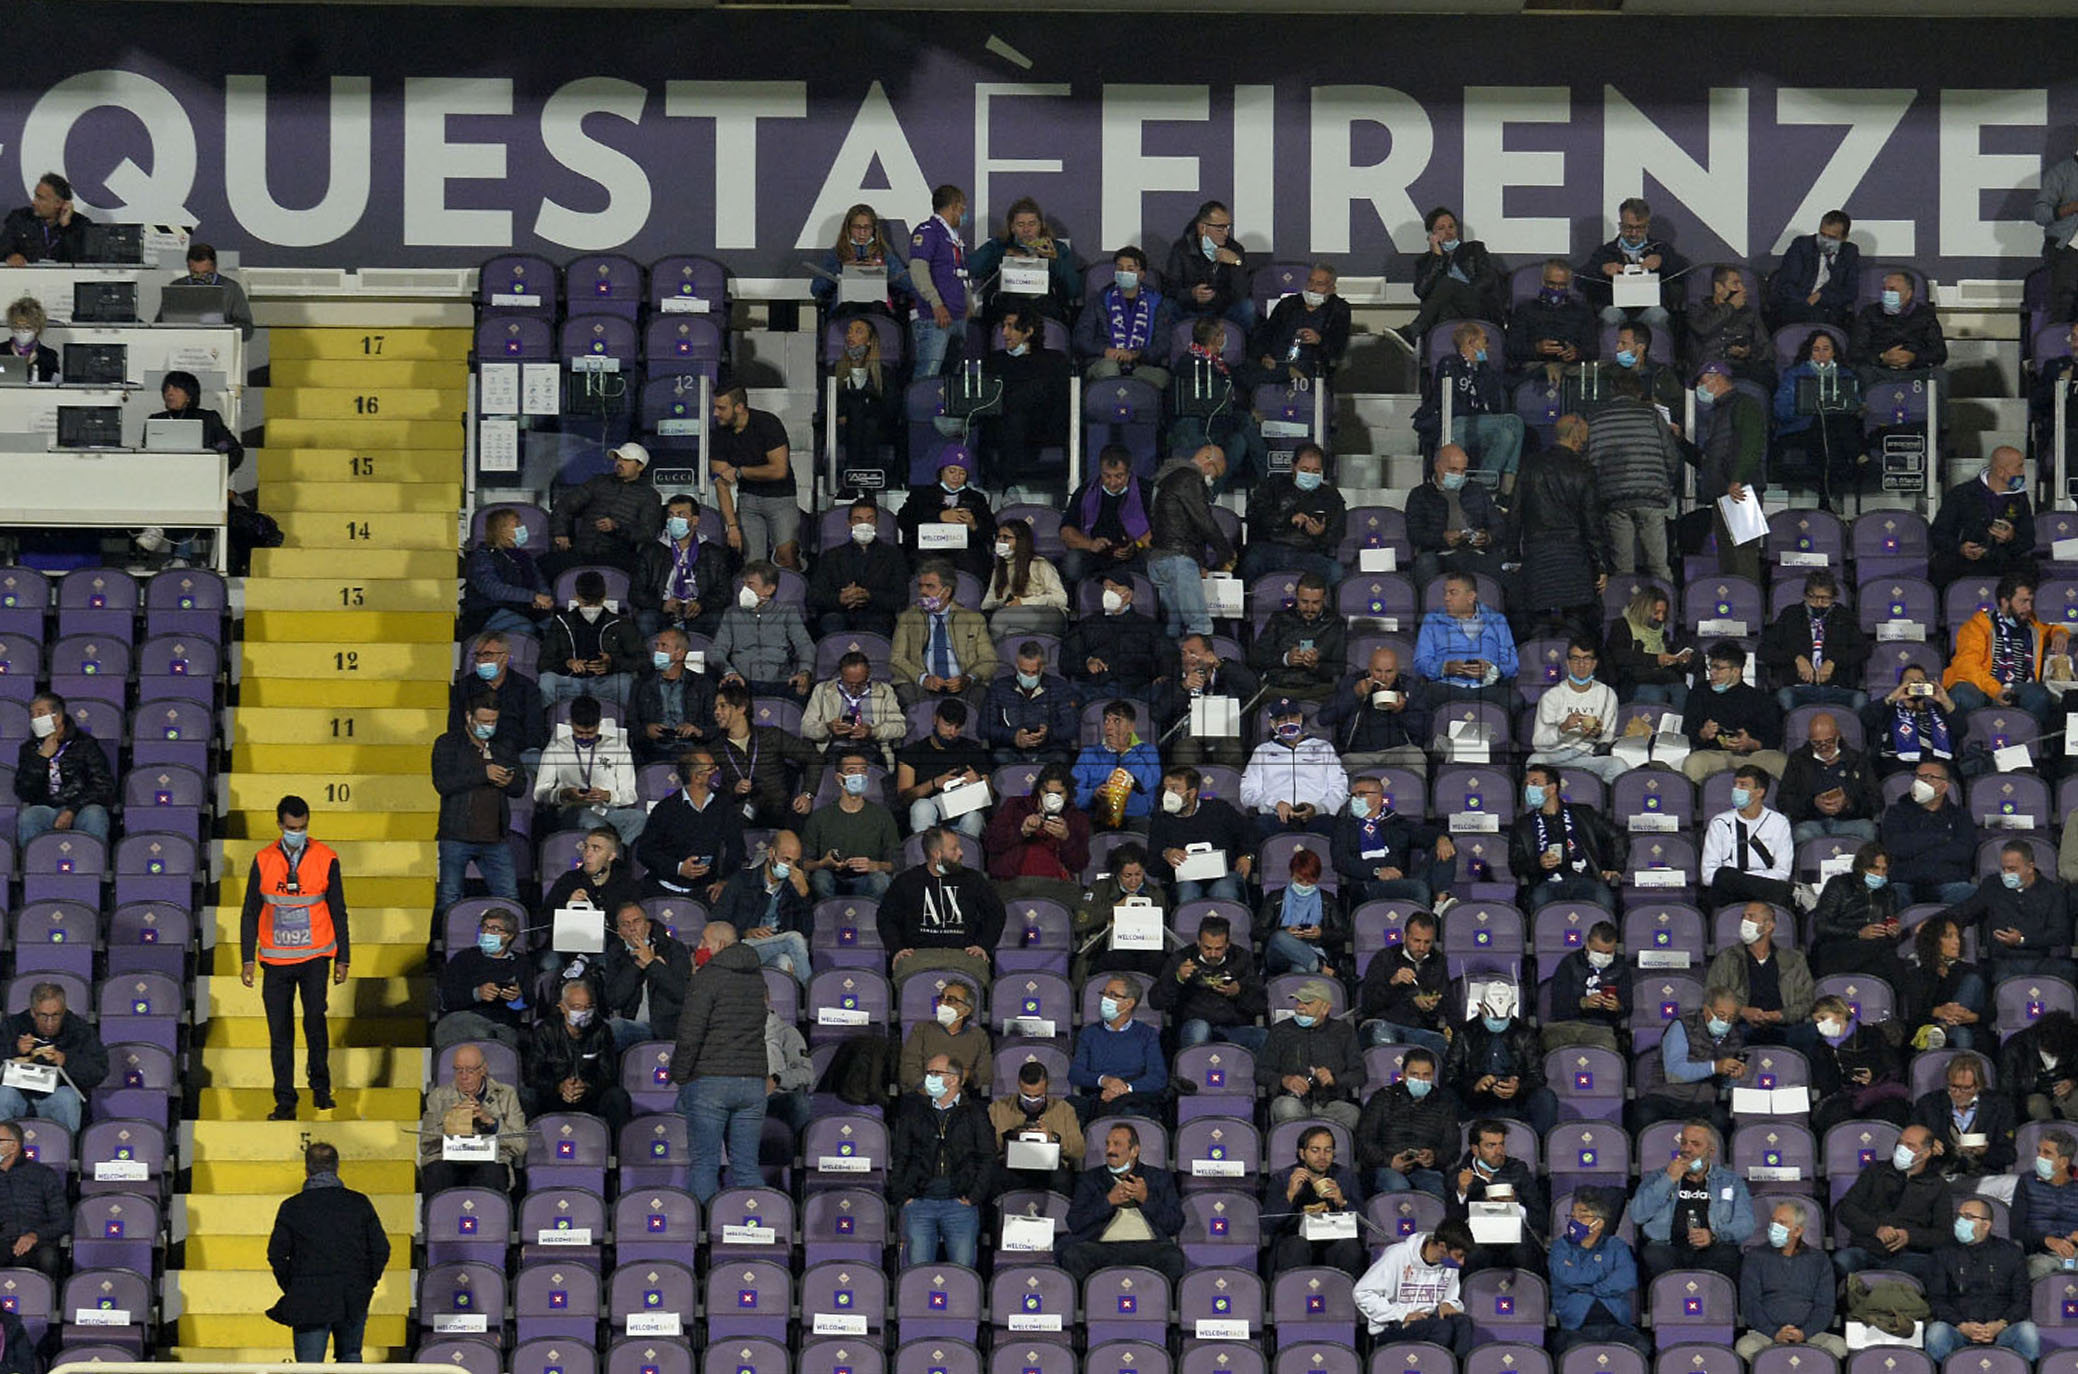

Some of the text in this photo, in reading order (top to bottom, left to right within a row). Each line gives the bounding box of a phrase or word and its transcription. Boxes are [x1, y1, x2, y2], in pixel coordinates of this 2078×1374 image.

[361, 337, 384, 355] 17
[675, 376, 693, 390] 12
[1291, 379, 1308, 392] 10
[1913, 380, 1923, 393] 8
[353, 396, 378, 414] 16
[350, 458, 373, 476] 15
[347, 522, 370, 540] 14
[340, 588, 364, 606] 13
[334, 652, 358, 671] 12
[1567, 706, 1595, 714] NAVY
[330, 719, 354, 737] 11
[325, 784, 350, 802] 10
[274, 929, 310, 944] 0092
[301, 1132, 311, 1151] 5
[1679, 1189, 1711, 1200] adida
